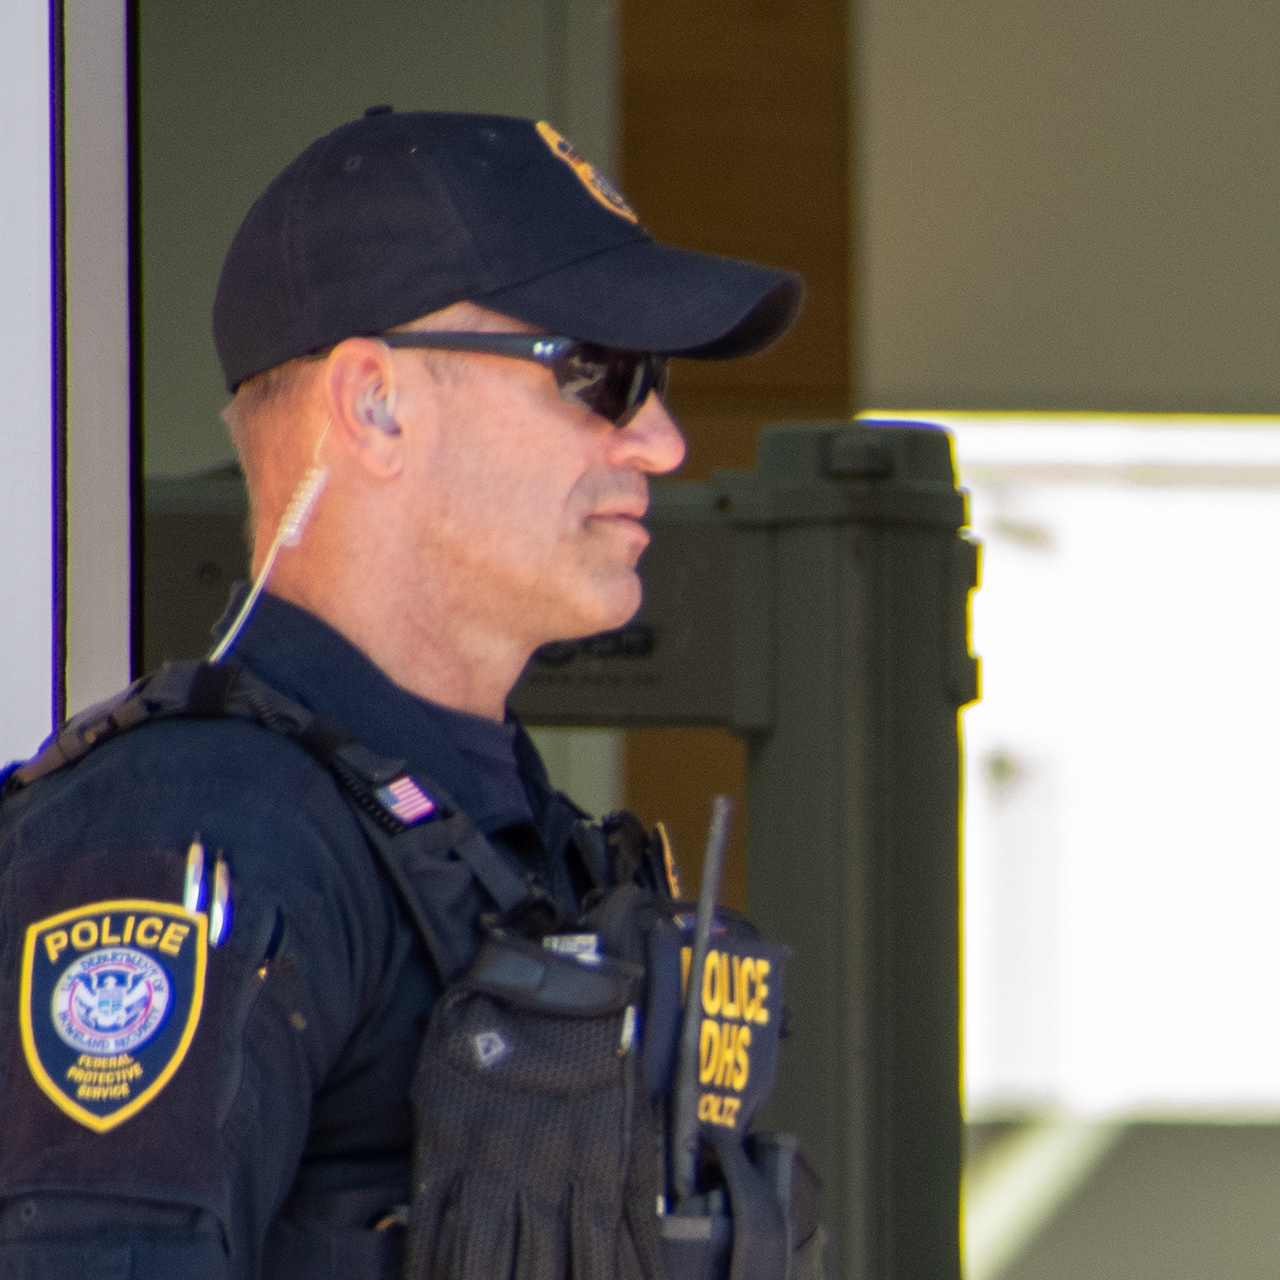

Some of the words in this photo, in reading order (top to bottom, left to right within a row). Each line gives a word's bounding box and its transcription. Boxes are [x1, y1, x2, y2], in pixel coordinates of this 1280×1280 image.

[44, 915, 190, 963] POLICE
[79, 1054, 134, 1069] FEDERAL
[700, 1019, 752, 1091] DHS
[67, 1063, 143, 1083] PROTECTIVE
[77, 1083, 130, 1100] SERVICE
